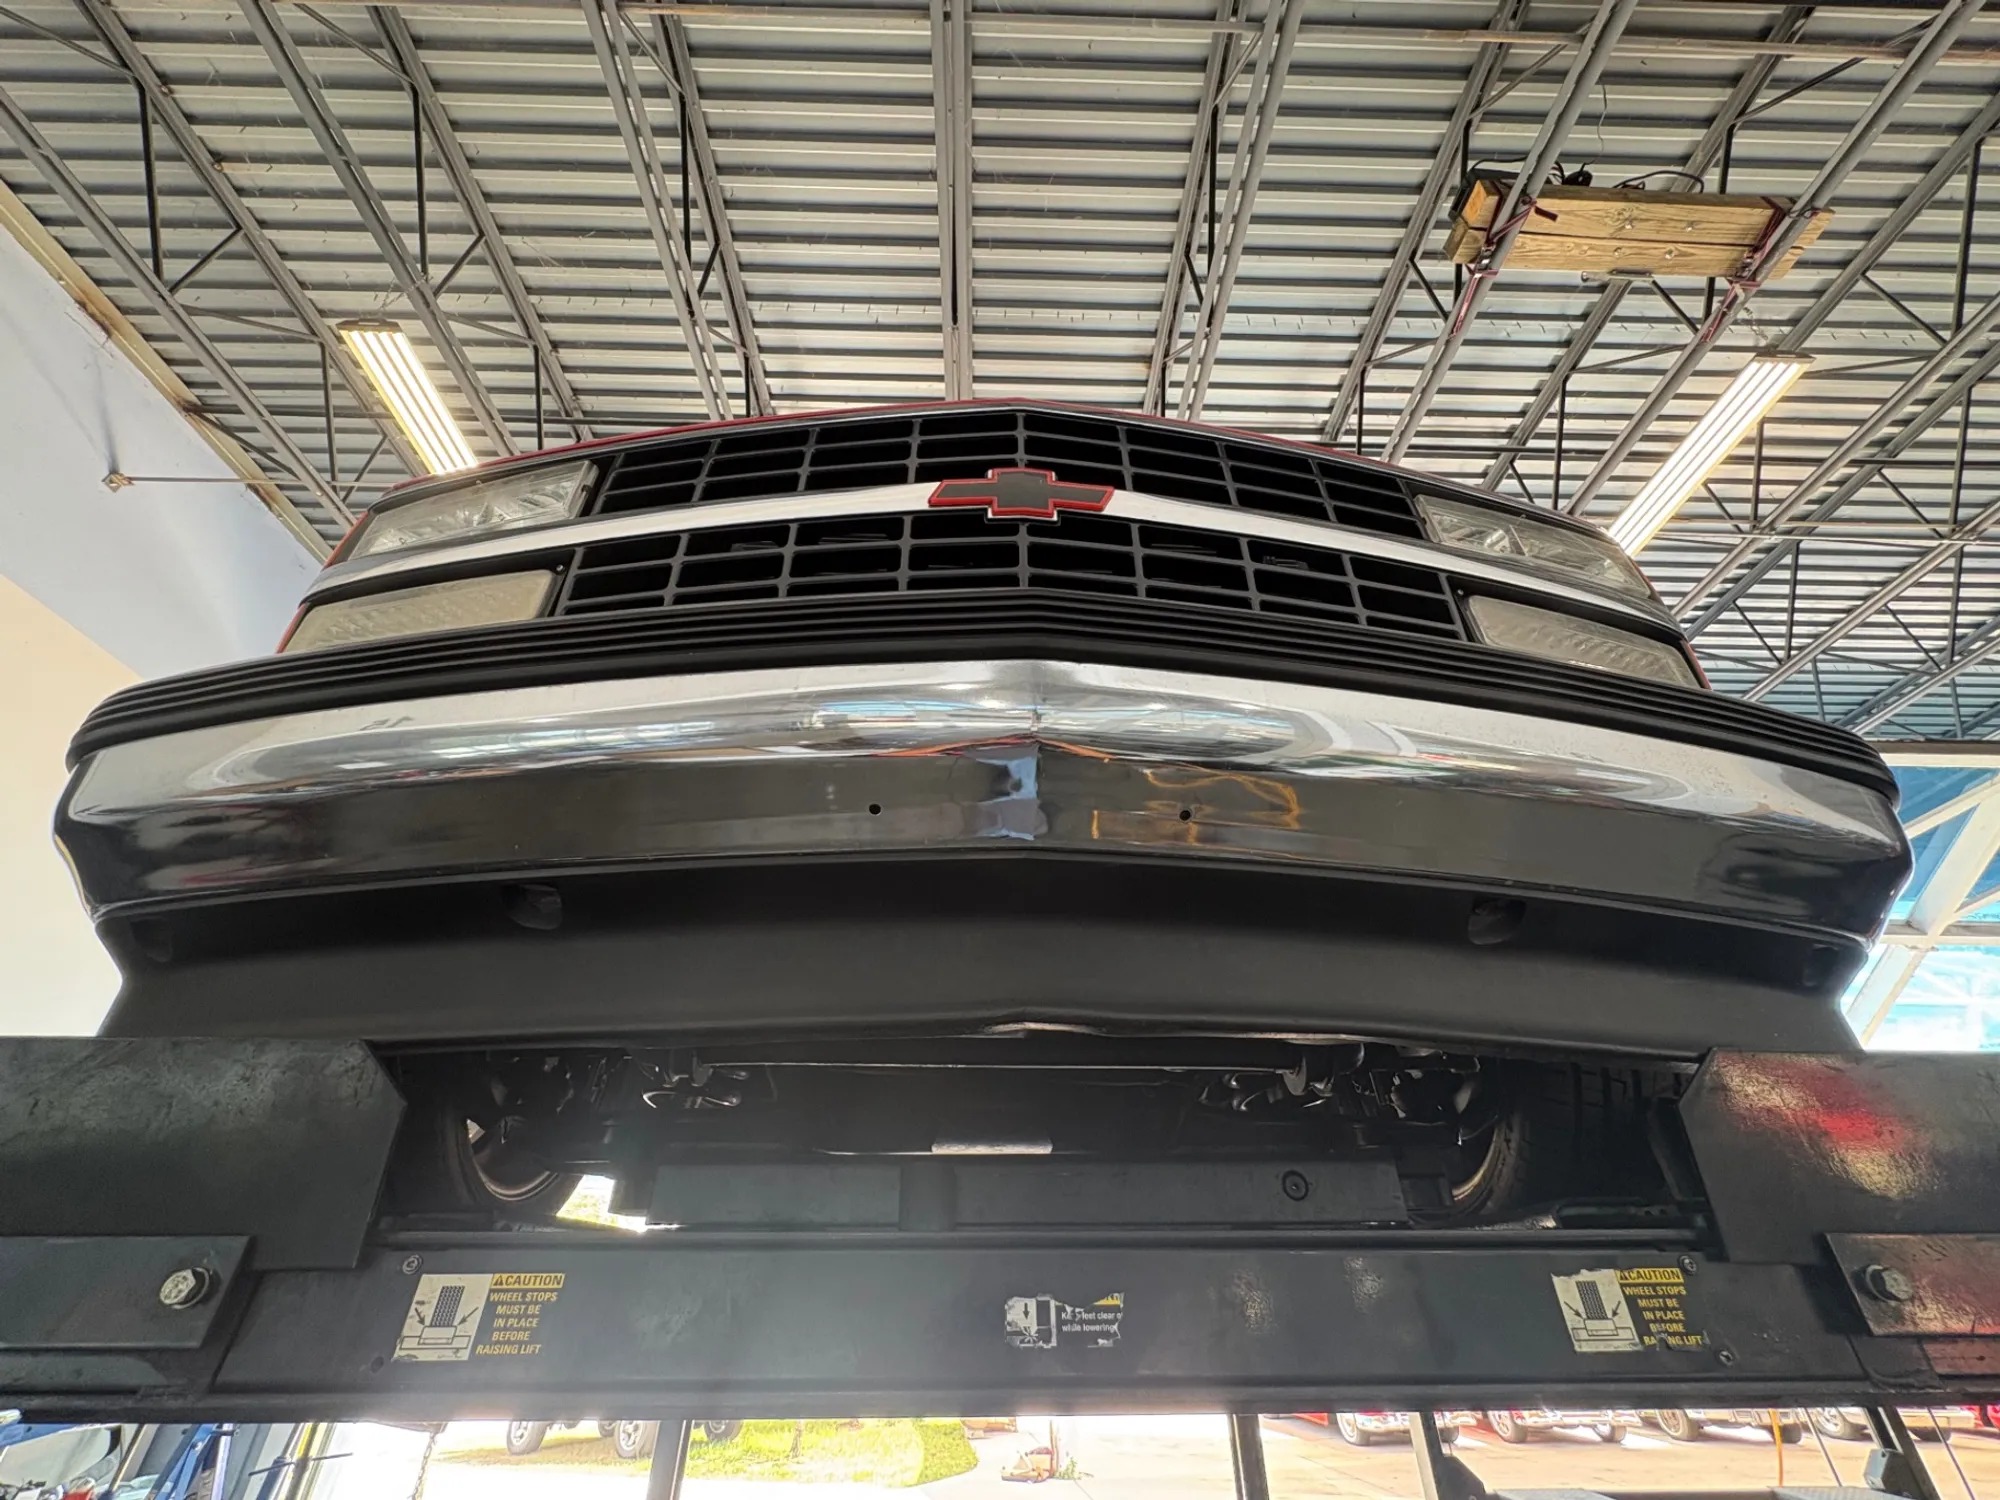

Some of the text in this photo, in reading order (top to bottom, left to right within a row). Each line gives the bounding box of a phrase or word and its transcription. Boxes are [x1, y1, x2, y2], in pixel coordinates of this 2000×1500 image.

[1629, 1269, 1680, 1280] CAUTION
[505, 1275, 562, 1286] CAUTION
[1623, 1286, 1687, 1295] WHEEL STOPS
[490, 1292, 558, 1301] WHEEL STOPS
[1637, 1299, 1679, 1307] MUST BE
[496, 1305, 542, 1314] MUST BE
[1097, 1311, 1115, 1320] clear
[1643, 1311, 1685, 1319] IN PLACE
[494, 1318, 539, 1327] IN PLACE
[1083, 1323, 1114, 1333] lowering
[492, 1331, 531, 1341] BEFORE
[1643, 1335, 1702, 1345] RANG LIFT
[476, 1345, 541, 1354] RAISING LIFT
